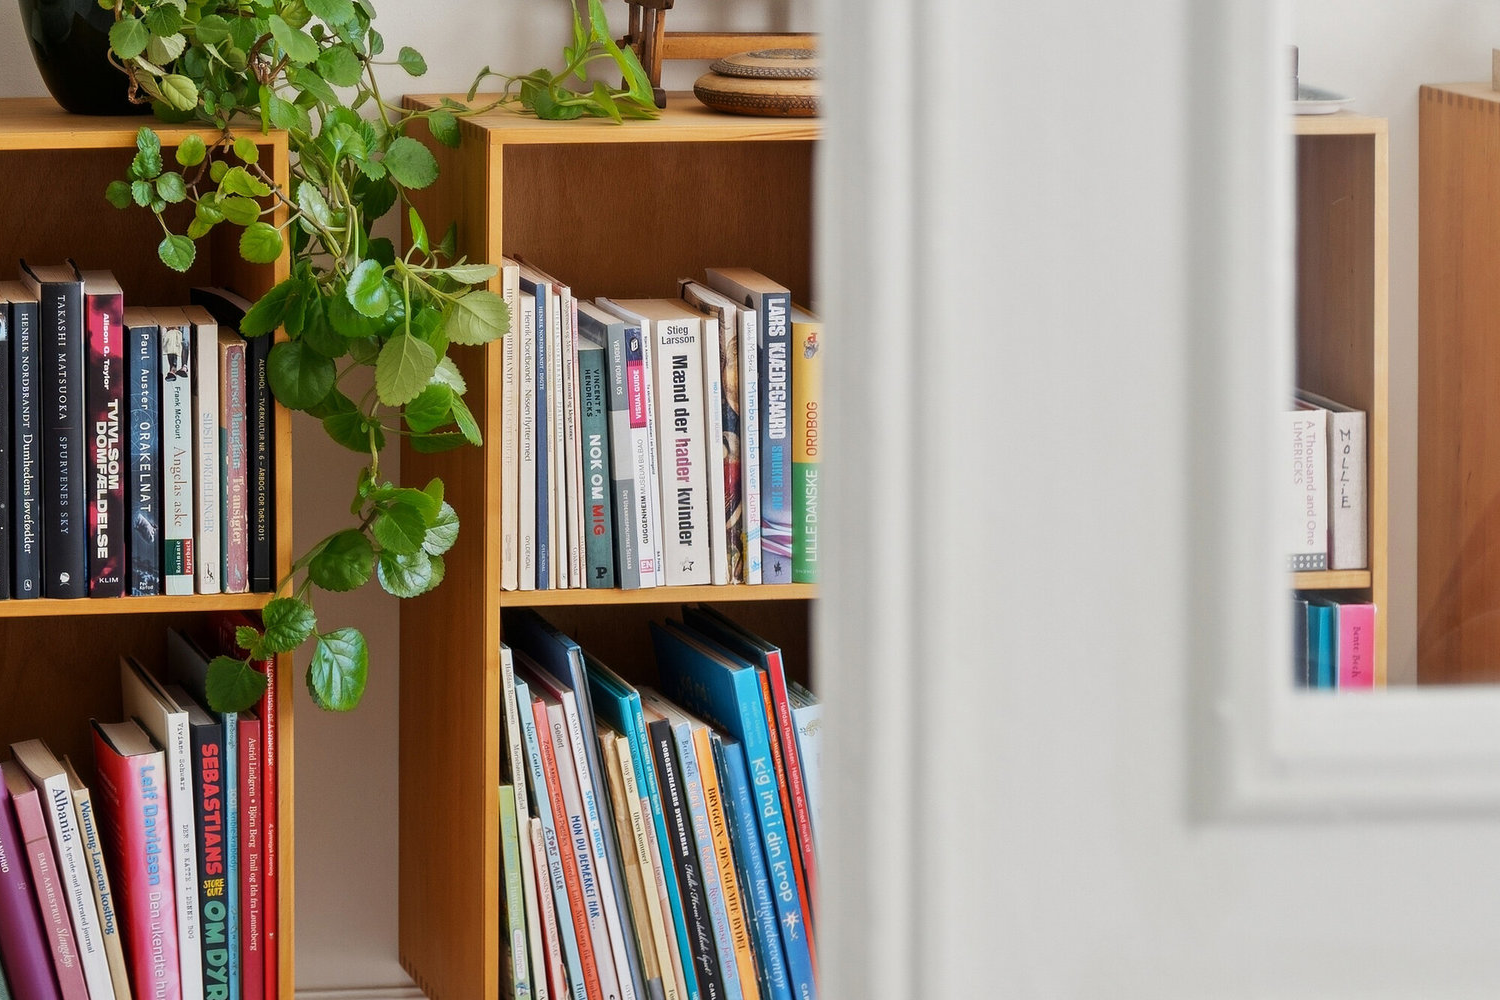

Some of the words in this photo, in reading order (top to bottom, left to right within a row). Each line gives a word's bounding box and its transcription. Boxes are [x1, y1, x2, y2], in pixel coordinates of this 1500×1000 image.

[21, 313, 29, 352] HENRIK
[57, 295, 66, 346] TAKASHI
[667, 326, 688, 336] Stieg
[768, 298, 785, 336] LARS
[140, 333, 150, 359] Paul
[662, 336, 694, 344] Larsson
[21, 356, 30, 427] NORDBRANDT
[57, 353, 67, 420] MATSUOKA
[140, 369, 150, 409] Auster
[584, 369, 592, 417] HENDRICKS
[672, 355, 689, 402] Mænd
[768, 342, 786, 439] KJÆDEGAARD
[634, 392, 642, 418] VISUAL
[674, 408, 689, 433] der
[107, 398, 118, 489] TVIVLSOM
[806, 401, 817, 455] ORDBOG
[1306, 420, 1315, 429] A
[22, 433, 33, 495] Dumhedens
[59, 436, 68, 505] SPURVENES
[138, 421, 151, 512] ORAKELNAT
[589, 434, 602, 469] NOK
[675, 438, 691, 482] hader
[1293, 421, 1303, 484] LIMERICKS
[1306, 432, 1316, 490] Thousand
[96, 421, 107, 558] DOMFÆLDELSE
[169, 446, 187, 496] Angelas
[591, 473, 603, 499] OM
[174, 501, 187, 526] aske
[803, 469, 818, 522] DANSKE
[1306, 494, 1316, 516] and
[23, 498, 34, 553] løvefødder
[60, 512, 68, 534] SKY
[592, 504, 605, 535] MIG
[677, 488, 694, 546] kvinder
[1306, 520, 1315, 545] One
[804, 525, 817, 561] LILLE
[248, 737, 256, 760] Astrid
[140, 766, 157, 800] Leif
[247, 762, 256, 796] Lindgren
[751, 756, 771, 786] kig
[52, 788, 74, 842] Albania
[201, 743, 222, 874] SEBASTIANS
[247, 806, 256, 827] Björn
[660, 739, 679, 807] MORGENTHALERS
[674, 807, 689, 856] DYREFABLER
[760, 789, 778, 817] ind
[248, 829, 256, 847] Berg
[570, 815, 583, 836] MON
[575, 837, 586, 851] DU
[766, 831, 783, 858] din
[143, 804, 161, 886] Davidsen
[79, 799, 105, 892] Warming-Larsens
[100, 892, 114, 935] kostbog
[203, 878, 224, 889] STORE
[248, 872, 255, 882] og
[578, 853, 596, 898] BEMÆRKET
[772, 860, 793, 902] krop
[207, 888, 223, 896] QUIZ
[249, 884, 257, 896] Ida
[204, 900, 226, 944] OM
